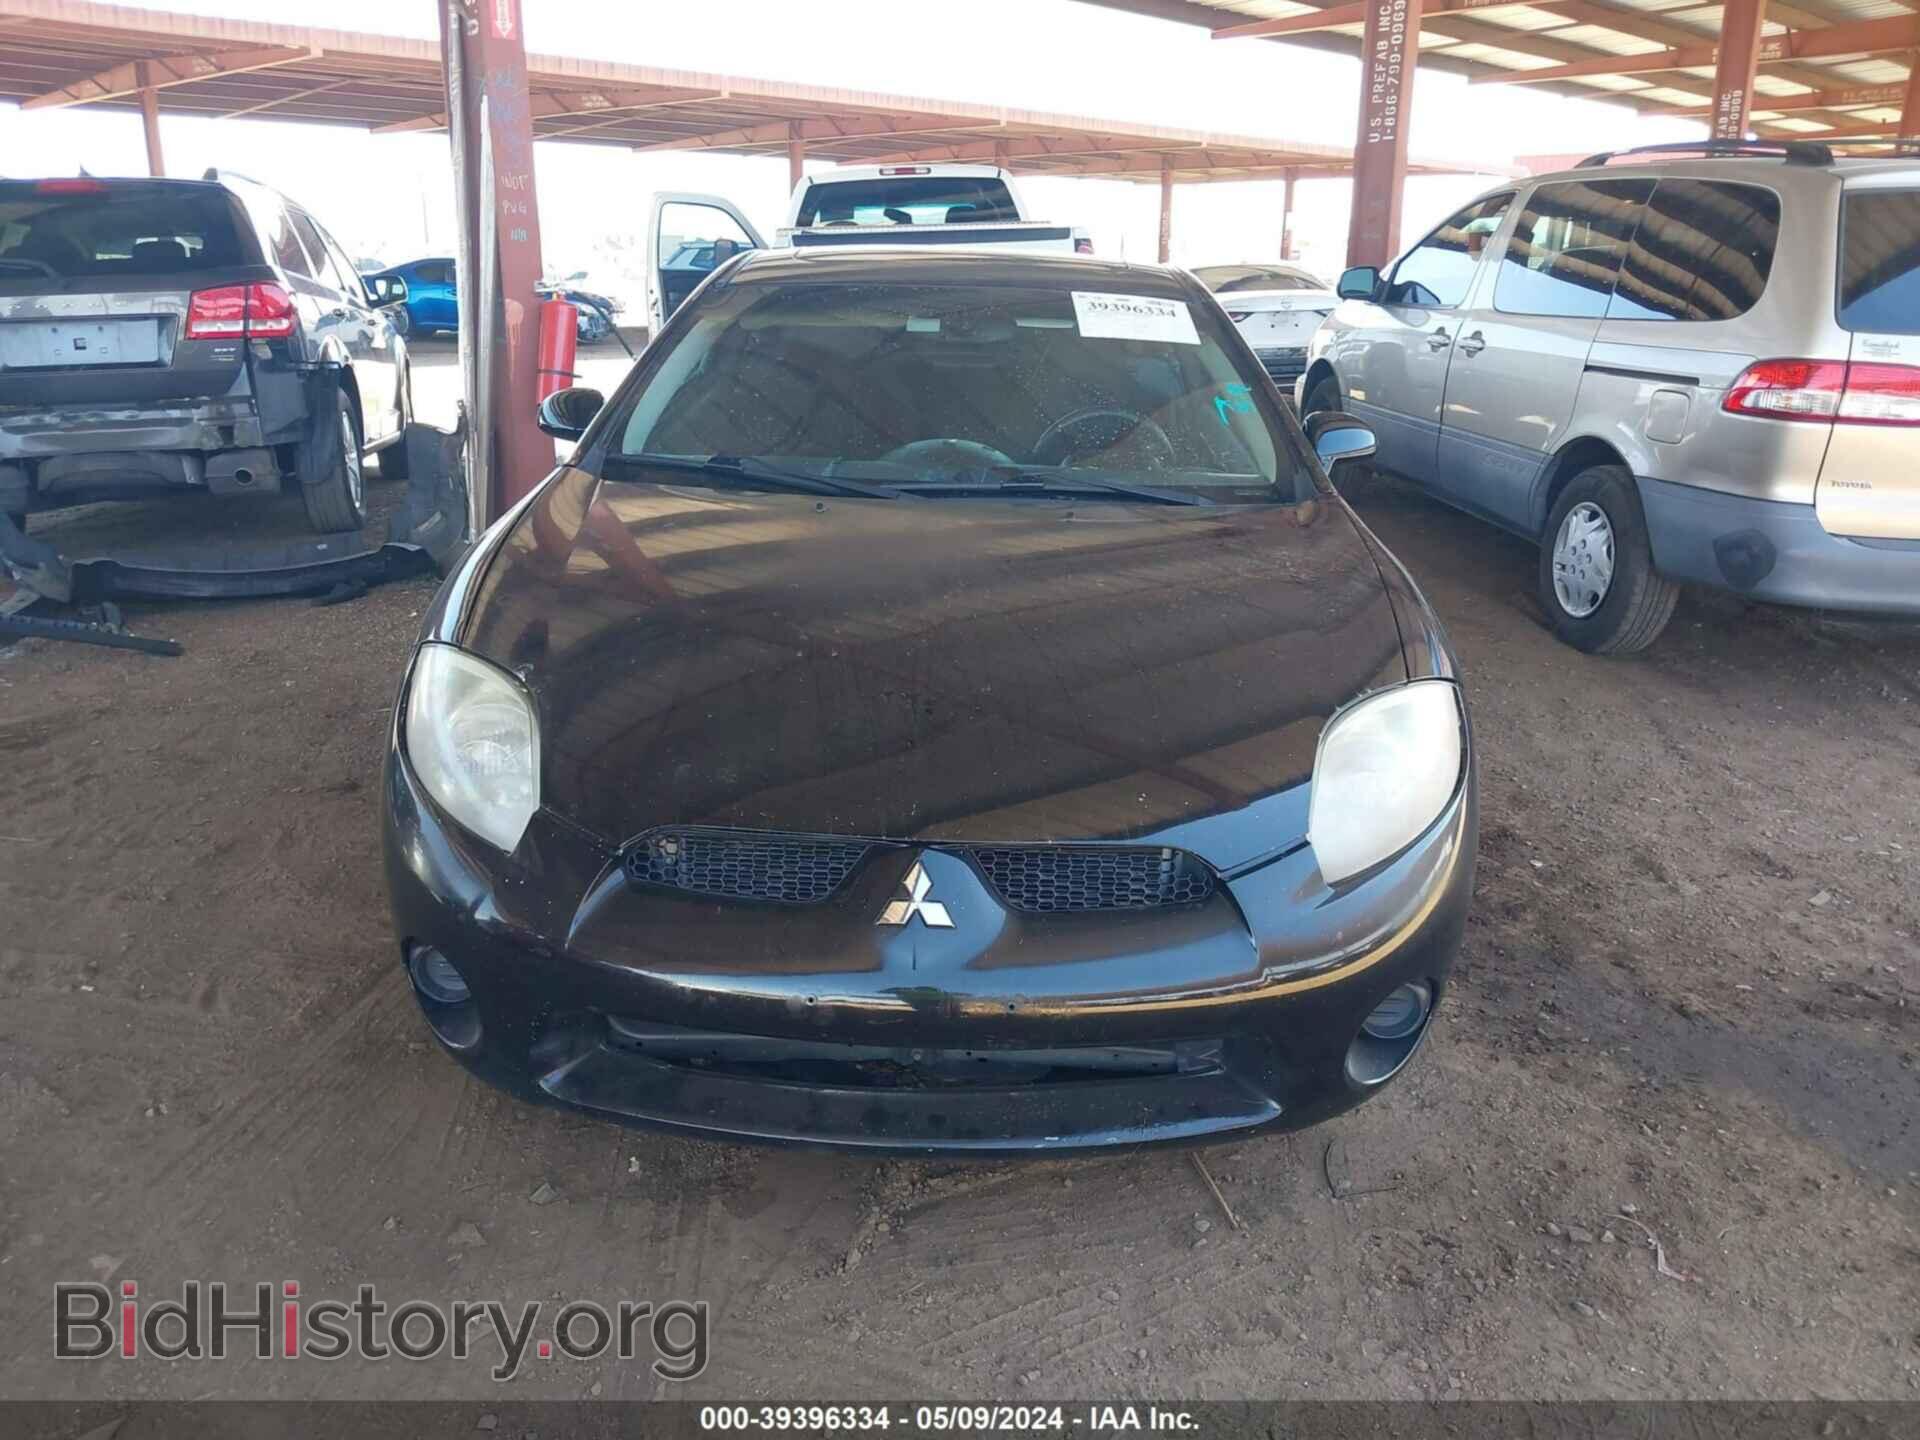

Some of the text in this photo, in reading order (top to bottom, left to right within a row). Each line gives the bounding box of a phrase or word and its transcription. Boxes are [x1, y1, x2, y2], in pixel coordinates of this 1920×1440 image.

[1368, 0, 1394, 143] U.S. PREFAB INC.
[1088, 301, 1177, 318] 39396334
